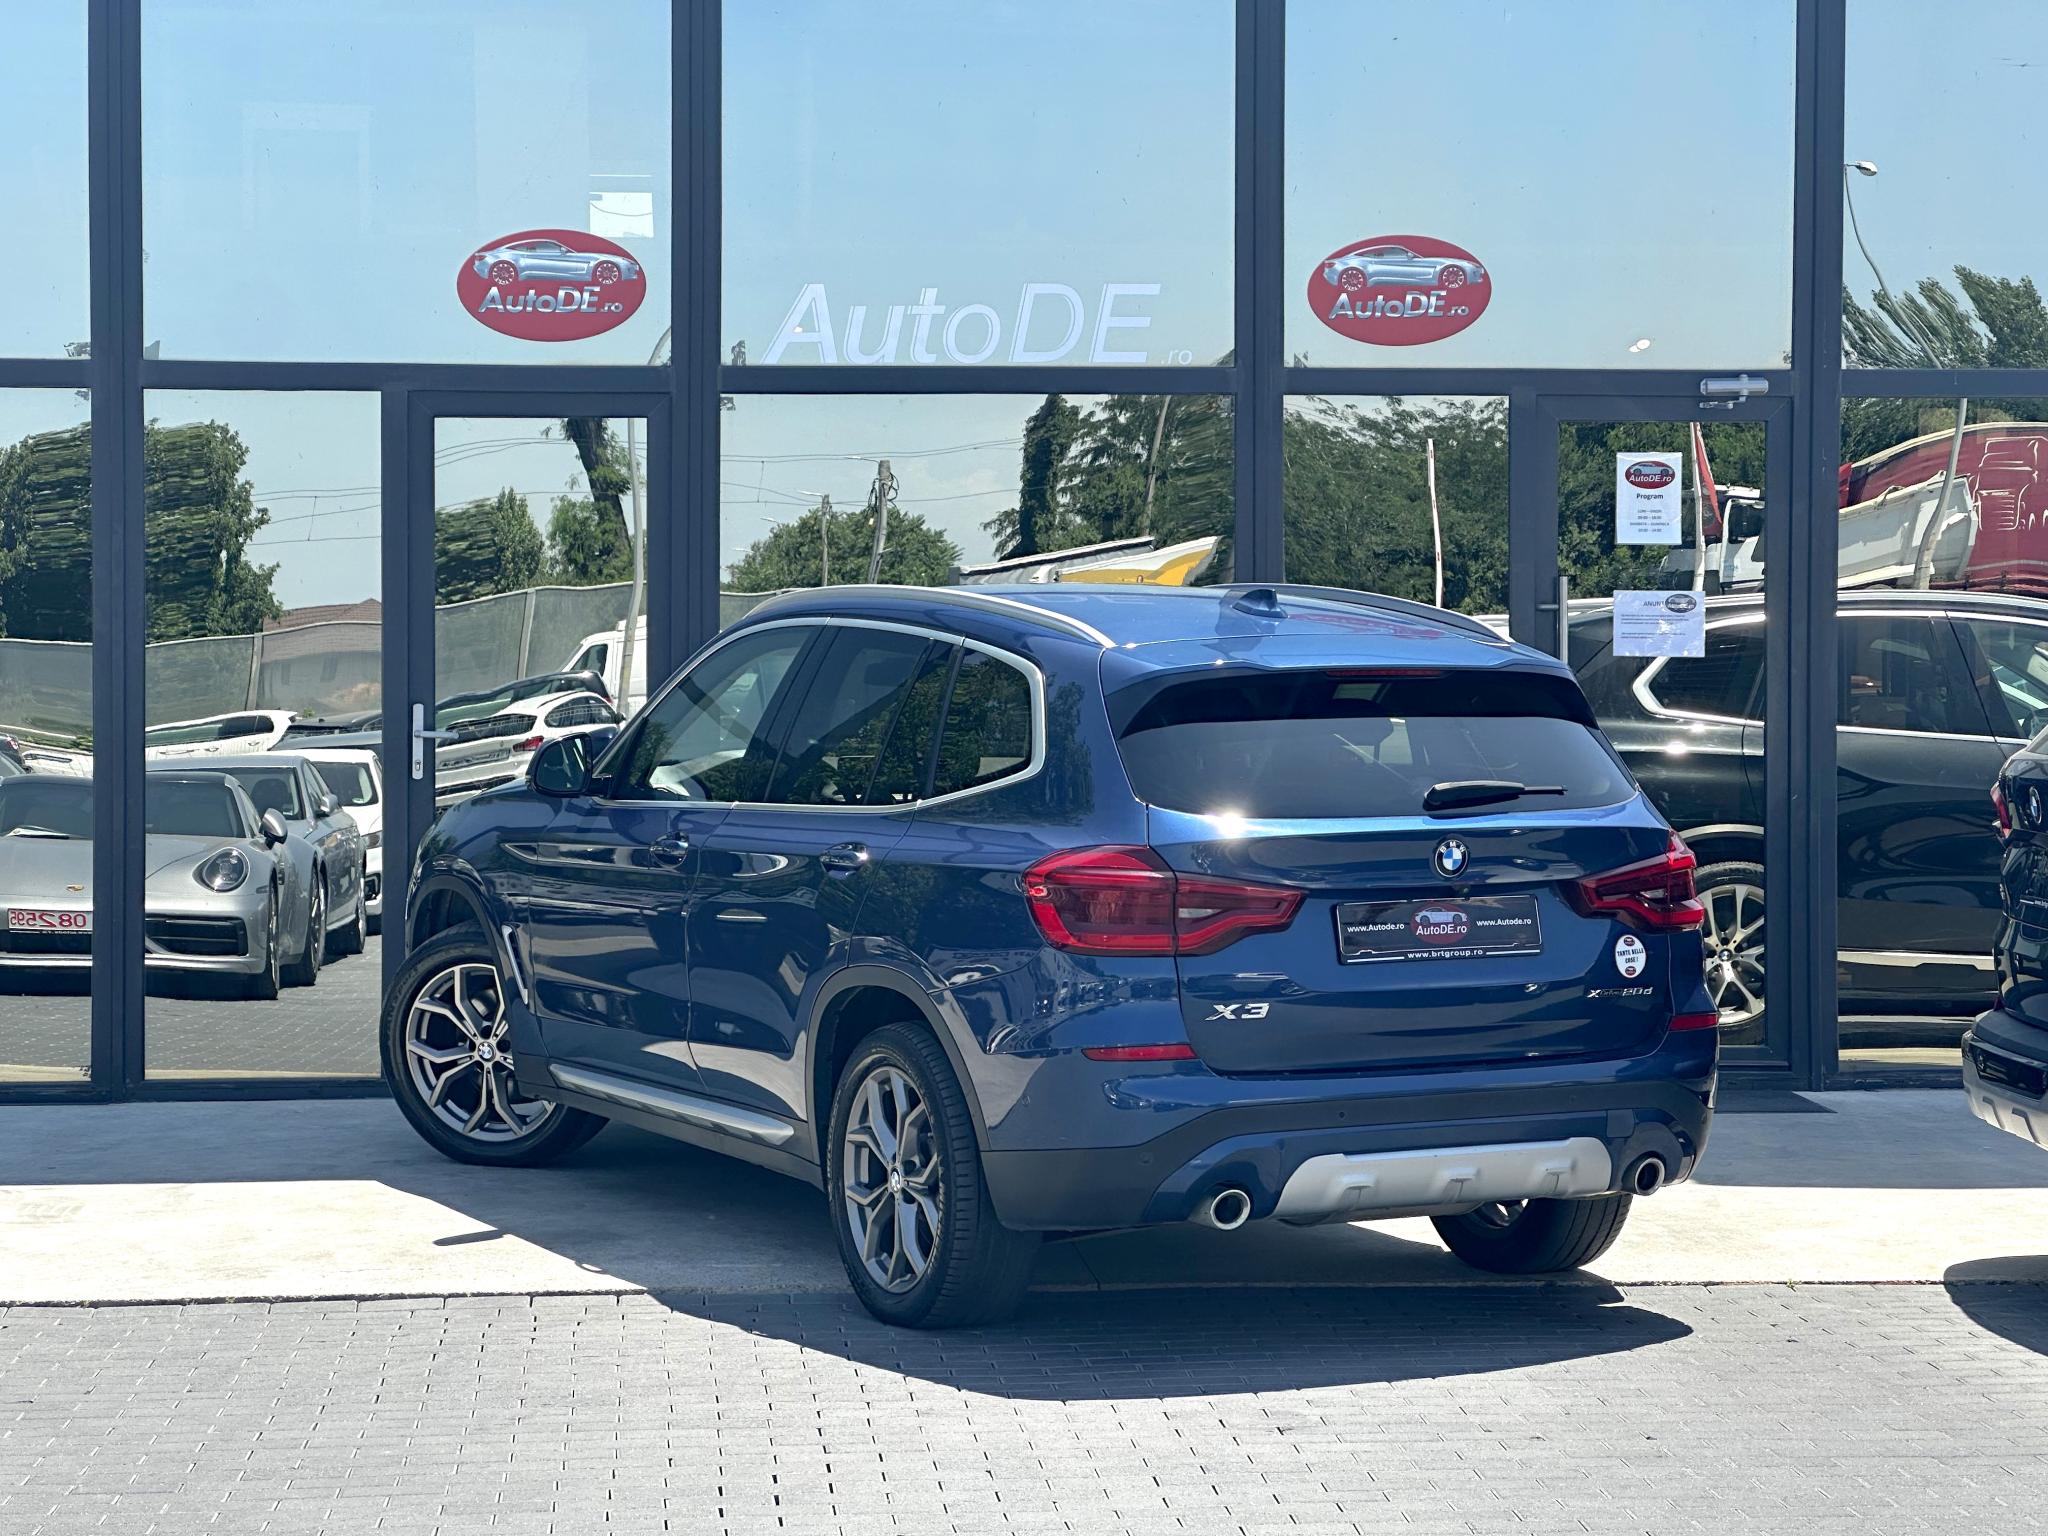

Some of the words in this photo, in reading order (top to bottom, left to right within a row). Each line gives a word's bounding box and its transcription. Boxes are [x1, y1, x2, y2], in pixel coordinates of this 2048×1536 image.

[1629, 474, 1672, 482] AutoDE.ro
[1636, 493, 1664, 501] Program
[1347, 922, 1405, 933] www.Autode.ro
[1476, 917, 1532, 927] www.Autode.ro
[1415, 923, 1467, 936] AutoDE.ro
[1407, 948, 1483, 959] www.brtgroup.ro
[1204, 1002, 1270, 1021] X3
